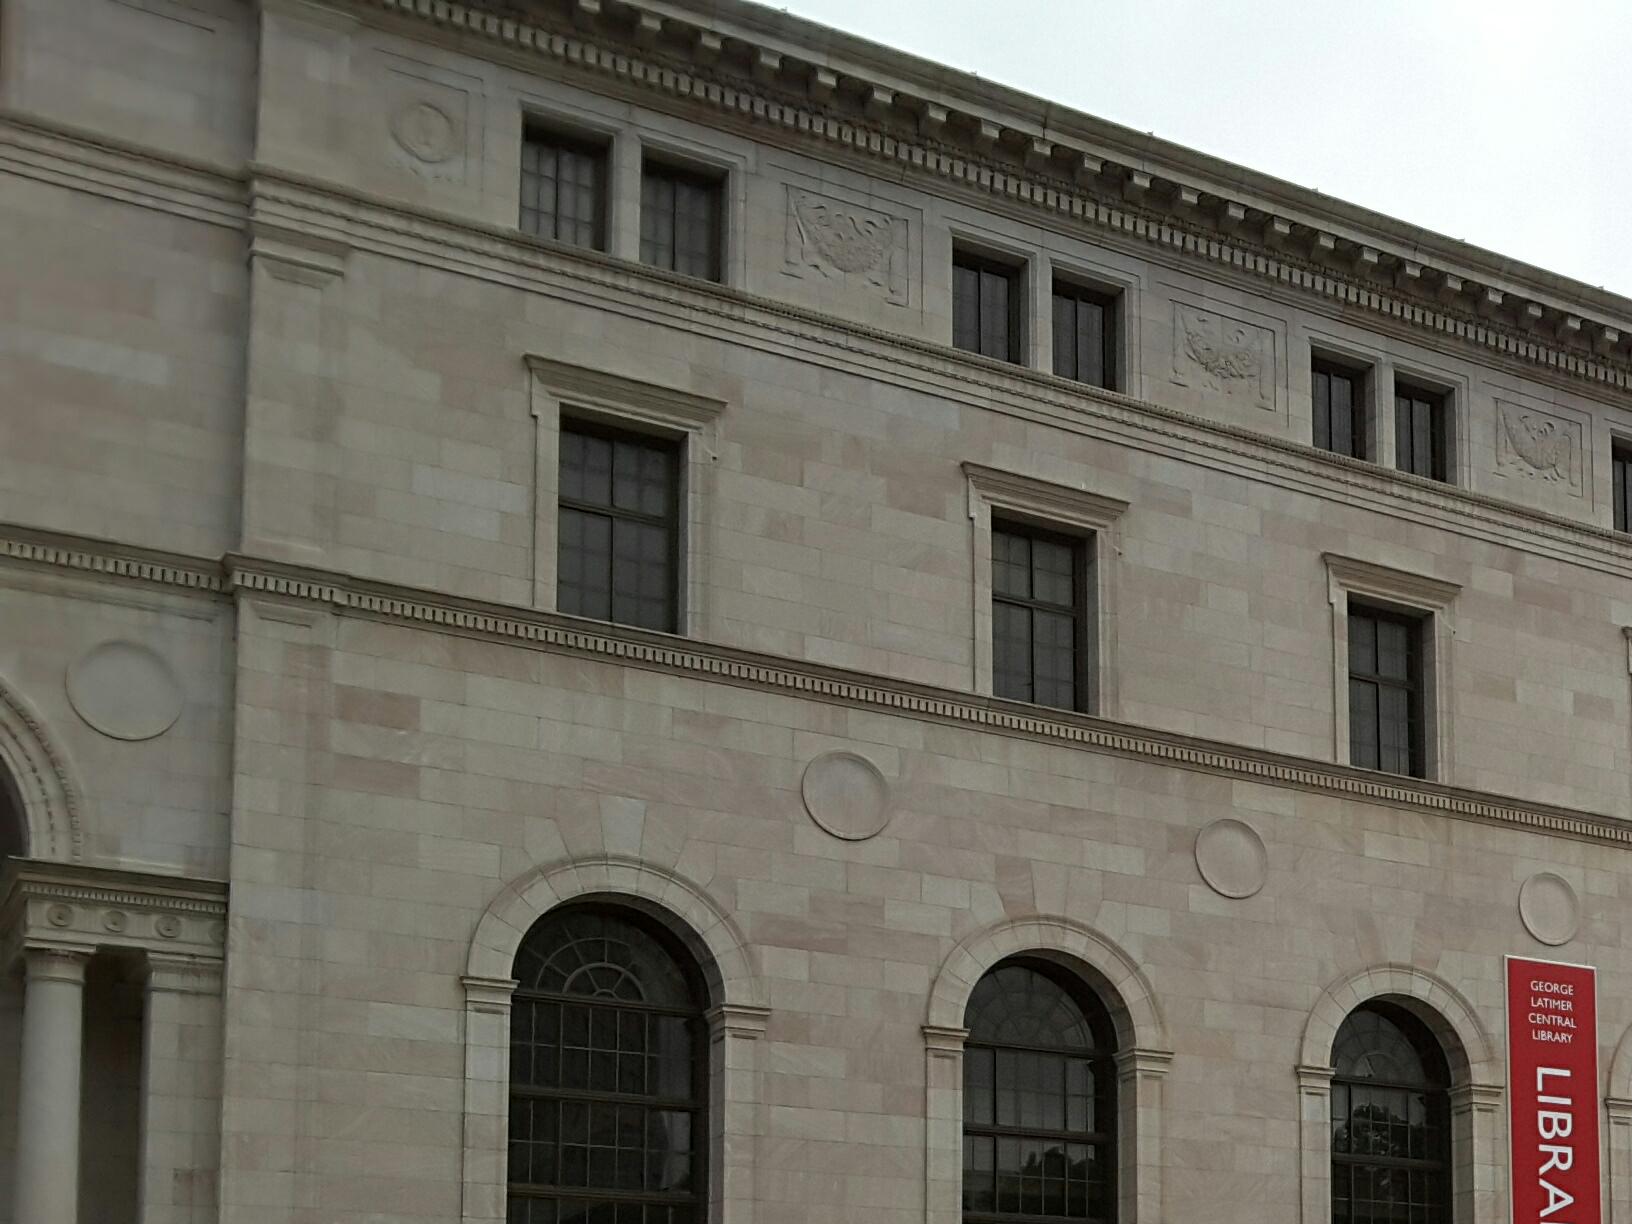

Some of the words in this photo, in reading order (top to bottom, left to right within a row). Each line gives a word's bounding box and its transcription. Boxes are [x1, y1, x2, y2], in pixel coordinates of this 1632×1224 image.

[1530, 980, 1574, 996] GEORGE
[1530, 996, 1573, 1012] LATIMER
[1528, 1012, 1577, 1029] CENTRAL
[1532, 1028, 1573, 1044] LIBRARY
